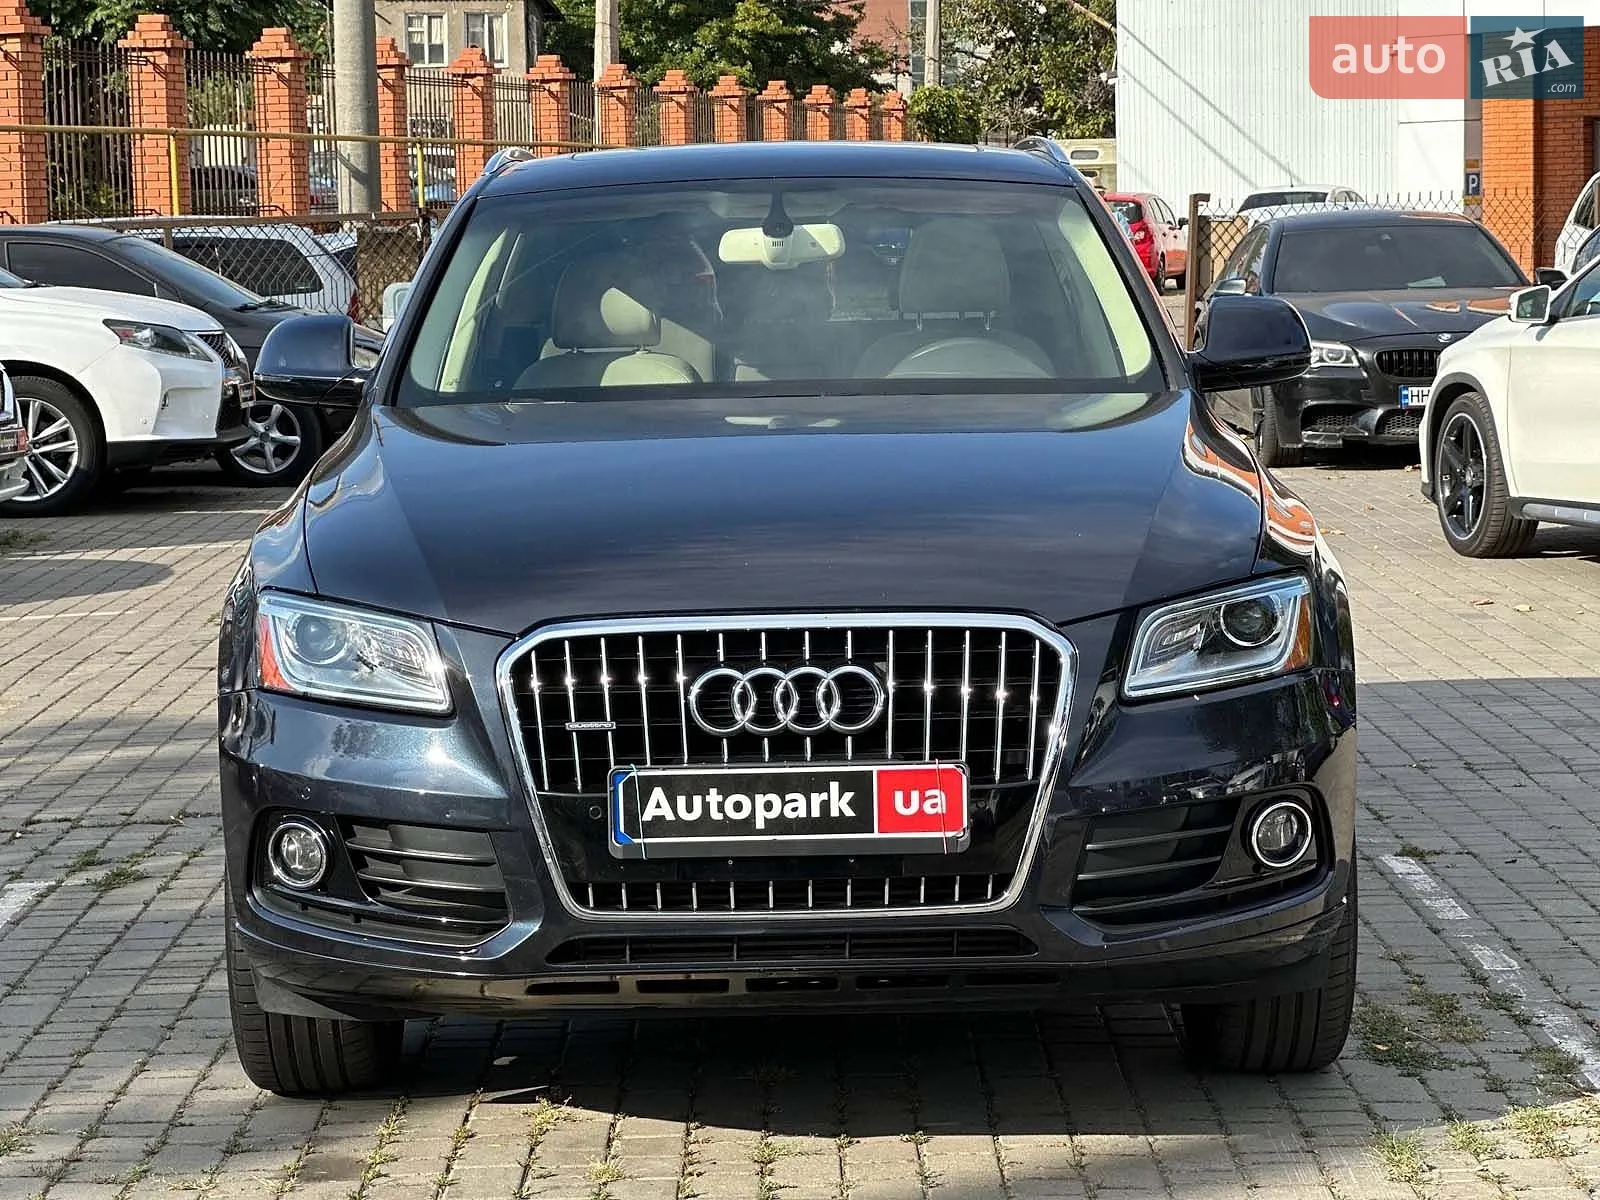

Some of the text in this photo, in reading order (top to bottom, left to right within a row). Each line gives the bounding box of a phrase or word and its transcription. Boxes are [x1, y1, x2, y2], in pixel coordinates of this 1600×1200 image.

[1468, 174, 1478, 195] P
[641, 781, 947, 829] Autopark ua
